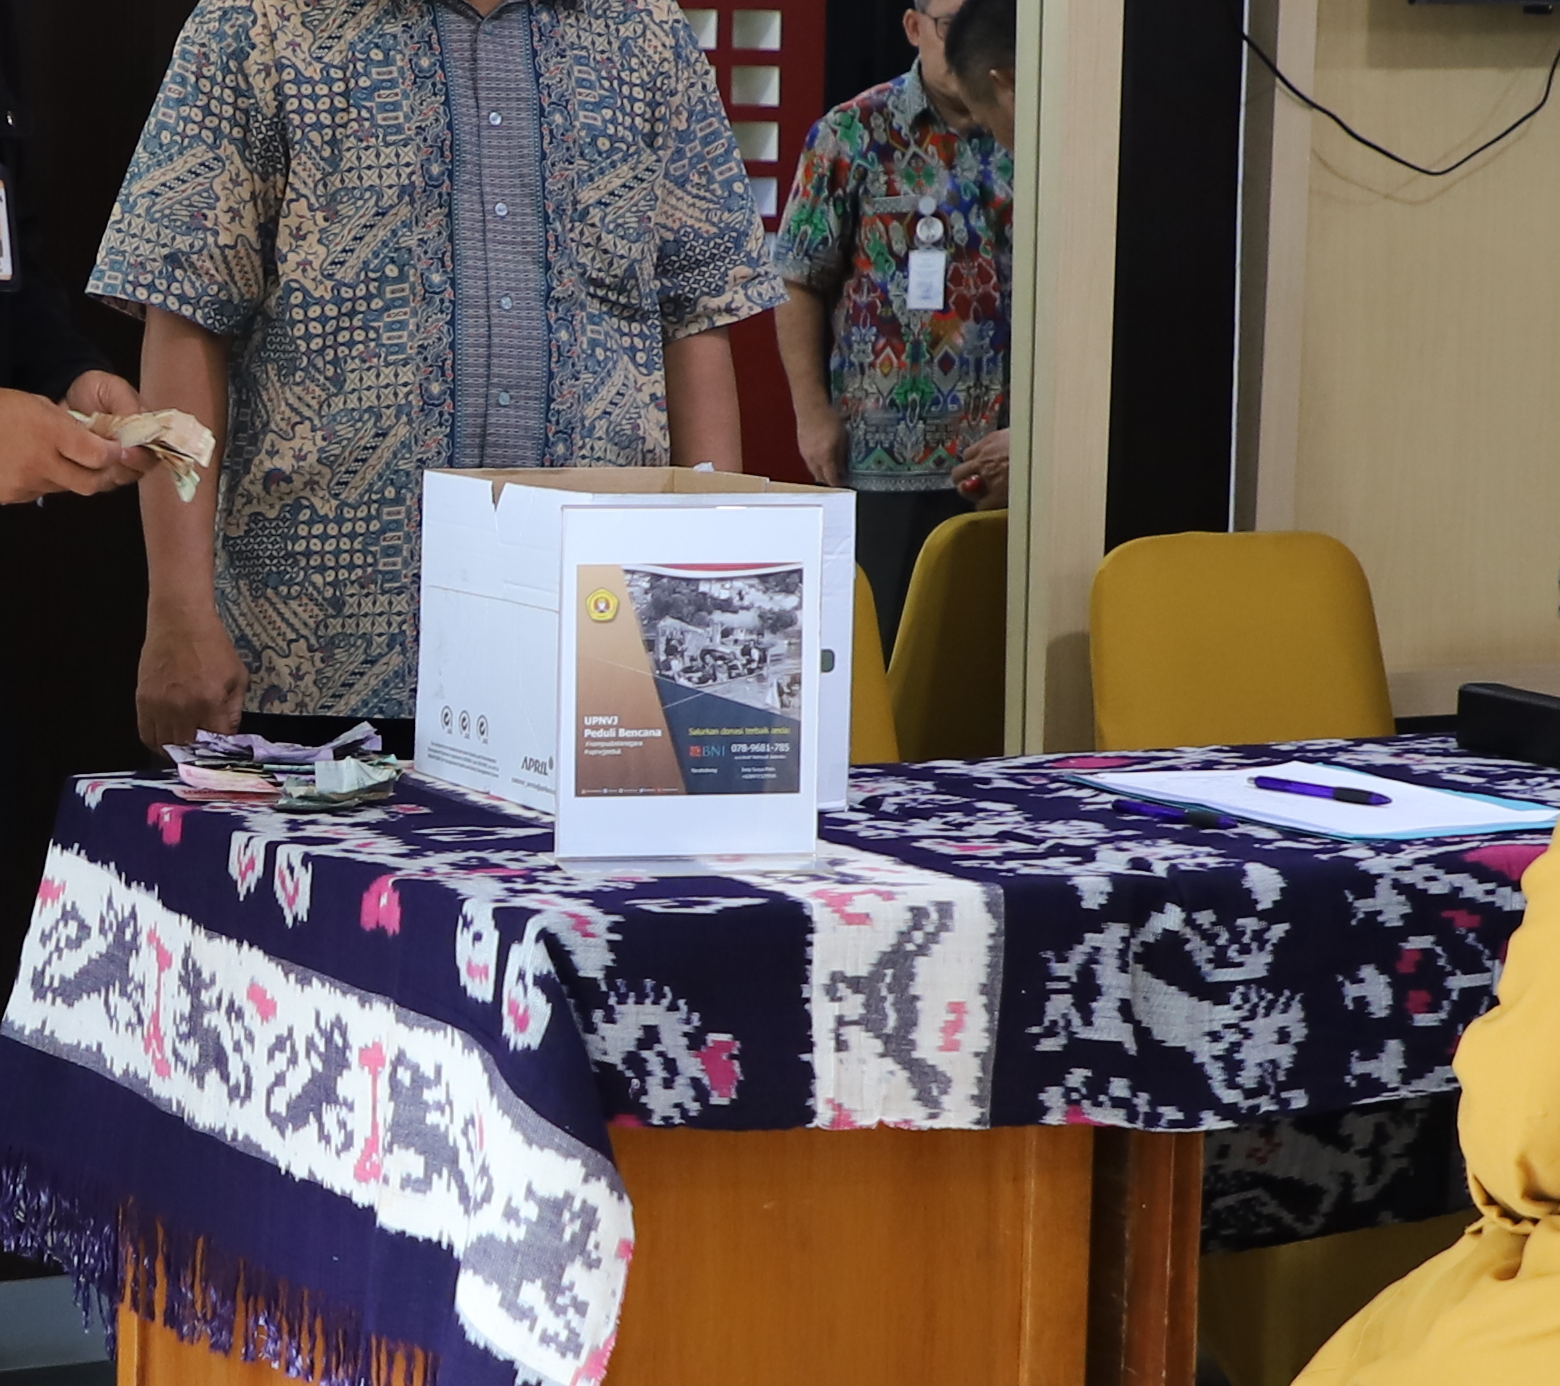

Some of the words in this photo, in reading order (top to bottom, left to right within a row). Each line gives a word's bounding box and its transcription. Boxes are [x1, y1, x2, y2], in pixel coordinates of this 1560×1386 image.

[583, 727, 616, 738] Peduli
[618, 728, 663, 738] Bencana
[702, 745, 726, 758] BNI
[521, 755, 549, 776] APRIL
